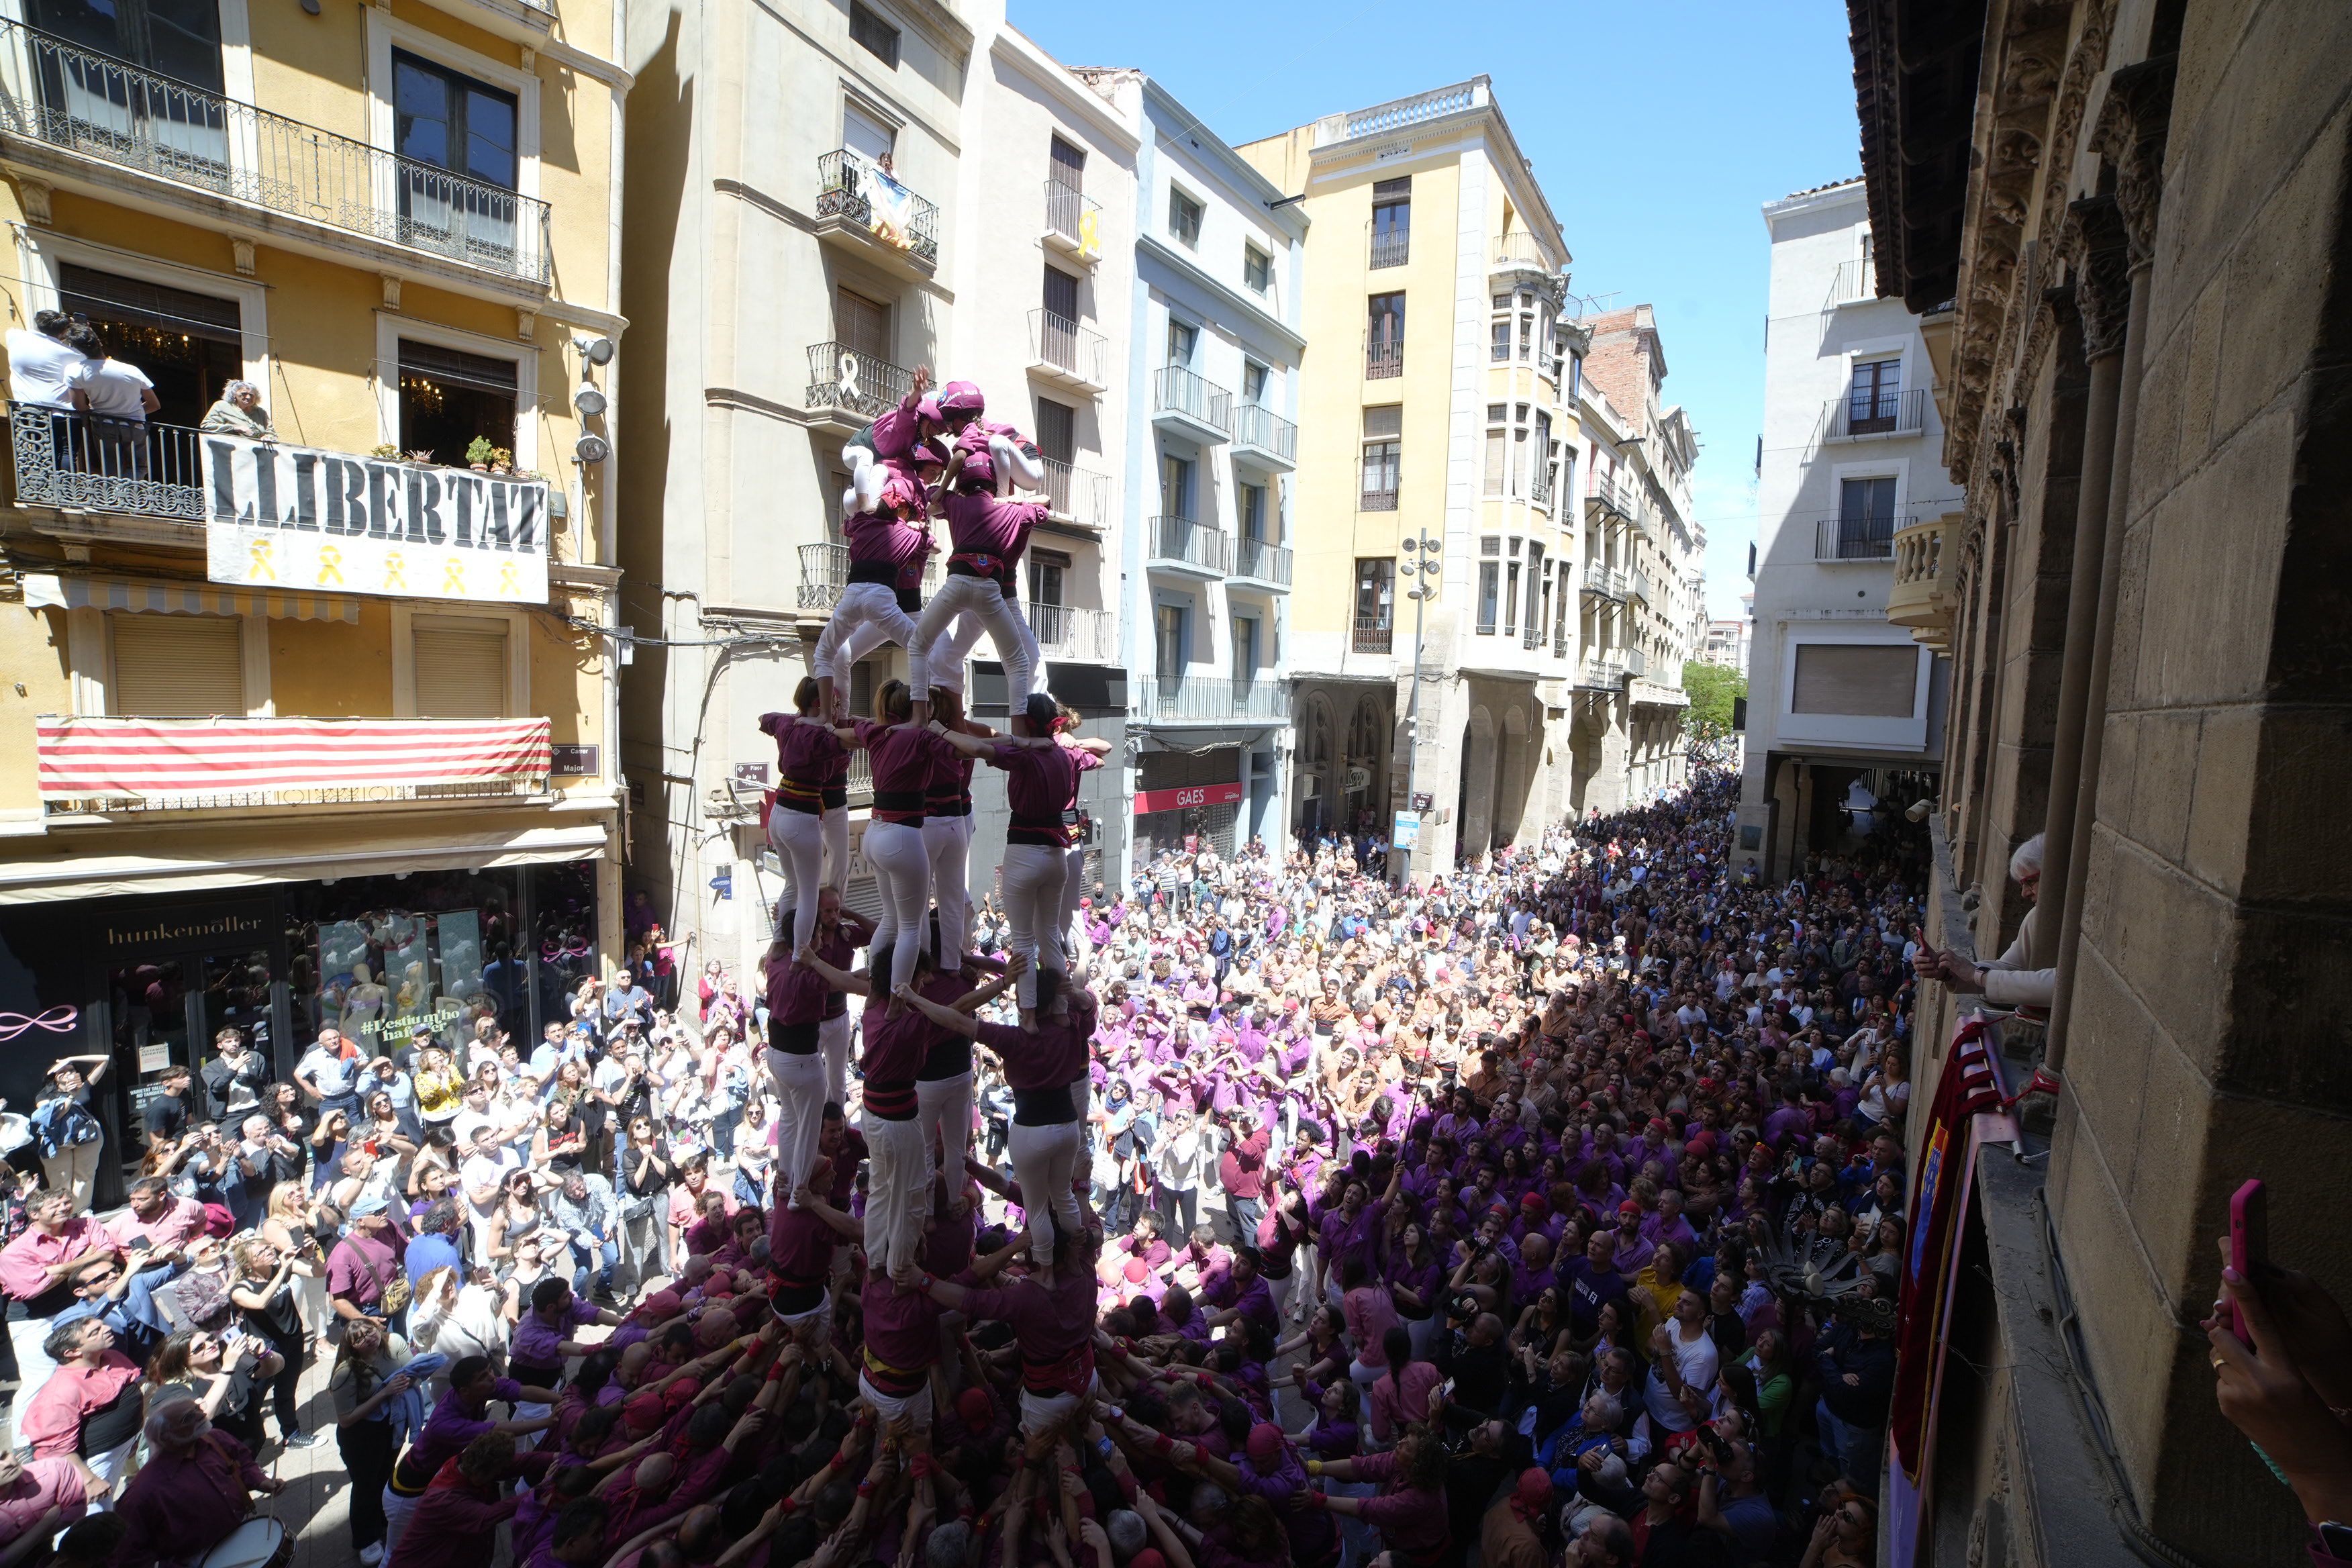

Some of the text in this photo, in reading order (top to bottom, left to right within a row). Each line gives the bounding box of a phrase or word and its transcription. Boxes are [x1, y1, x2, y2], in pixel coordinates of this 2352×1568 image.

[207, 440, 545, 554] LLIBERTAT
[564, 765, 584, 773] Major
[1177, 789, 1204, 805] GAES
[360, 1015, 421, 1035] #L'estiu
[423, 1009, 460, 1024] m'ho
